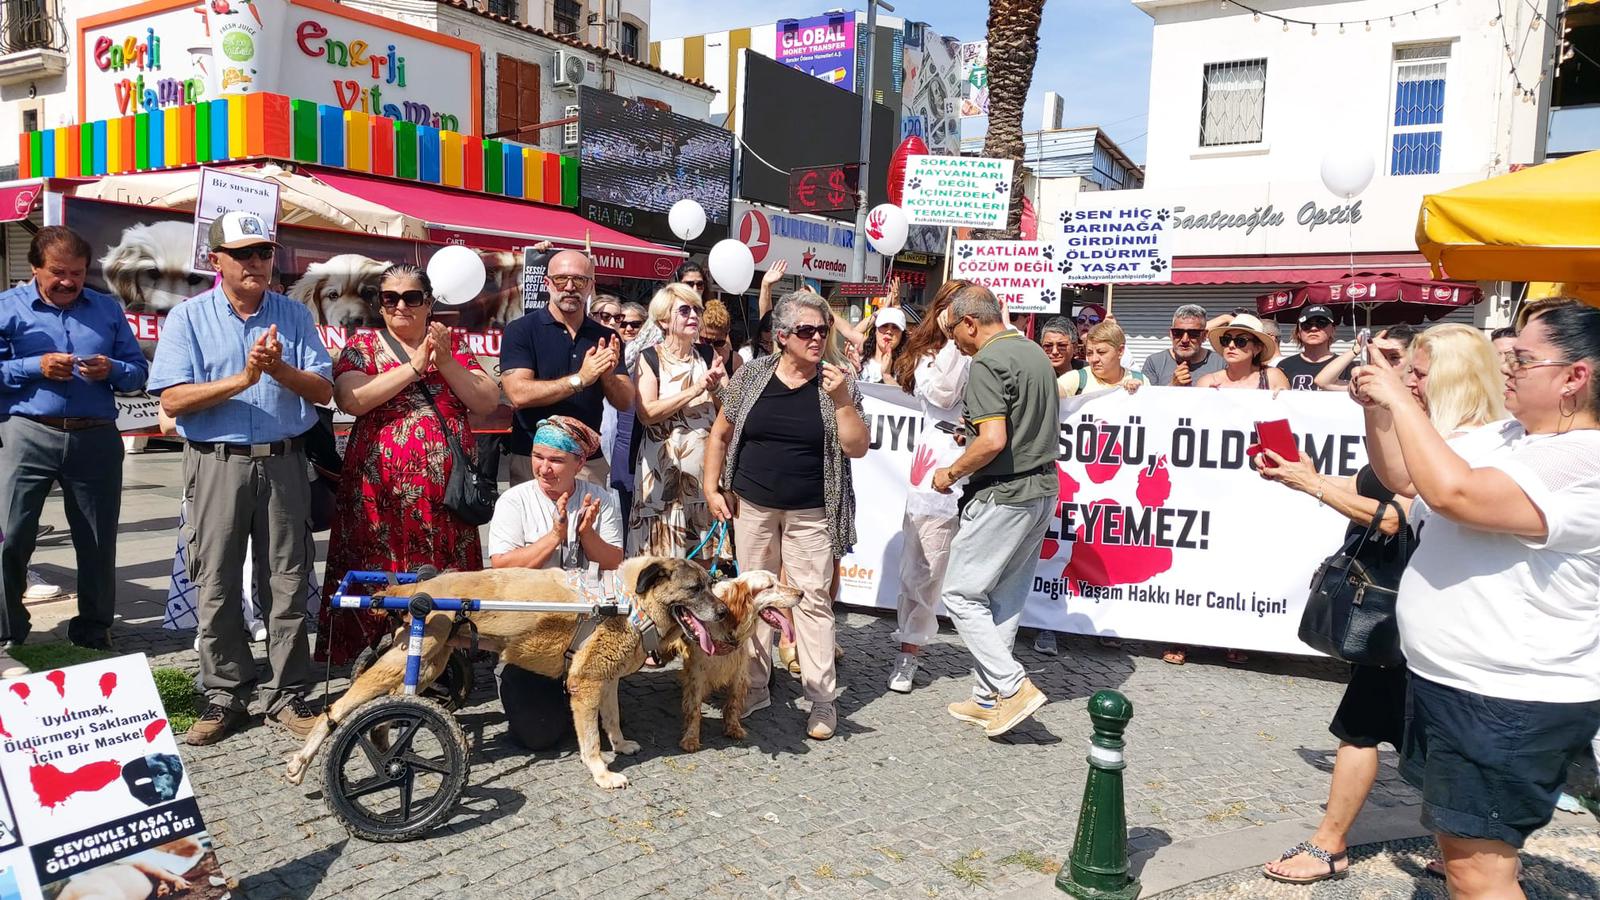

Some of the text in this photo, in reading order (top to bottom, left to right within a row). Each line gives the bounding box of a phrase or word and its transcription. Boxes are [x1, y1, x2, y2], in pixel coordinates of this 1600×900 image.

[782, 26, 845, 48] GLOBAL
[783, 42, 846, 55] MONEY TRANSFER
[920, 158, 1002, 169] SOKAKTAKİ
[915, 168, 1003, 179] HAYVANLARI
[212, 178, 270, 197] Biz susarsak
[938, 178, 979, 188] DEĞİL
[920, 188, 996, 199] İÇİNİZDEKİ
[907, 198, 1005, 210] KÖTÜLÜKLERİ
[913, 209, 998, 220] TEMİZLEYİN
[1075, 207, 1152, 220] SEN HİÇ
[1297, 200, 1363, 232] Optik
[772, 214, 829, 244] TURKISH
[1063, 220, 1163, 233] BARINAĞA
[1068, 233, 1157, 246] GİRDİNMİ
[976, 244, 1039, 256] KATLİAM
[1066, 248, 1159, 259] ÖLDÜRME
[593, 252, 625, 269] AMİN
[813, 258, 847, 273] corendon
[958, 259, 1054, 274] ÇÖZÜM DEĞİL
[1080, 262, 1141, 273] YAŞAT
[997, 293, 1025, 303] ENE
[1059, 413, 1157, 477] SÖZÜ,
[1046, 502, 1210, 550] LEYEMEZ!
[838, 564, 874, 580] ader
[1033, 576, 1287, 618] Değil, Yaşam Hakkı Her Canlı İçin!
[42, 704, 114, 728] Uyutmak,
[4, 709, 159, 754] Öldürmeyi Saklamak
[32, 728, 145, 765] İçin Bir Maske!
[128, 810, 179, 834] YAŞAT,
[141, 826, 171, 843] DUR
[173, 816, 196, 833] DE!
